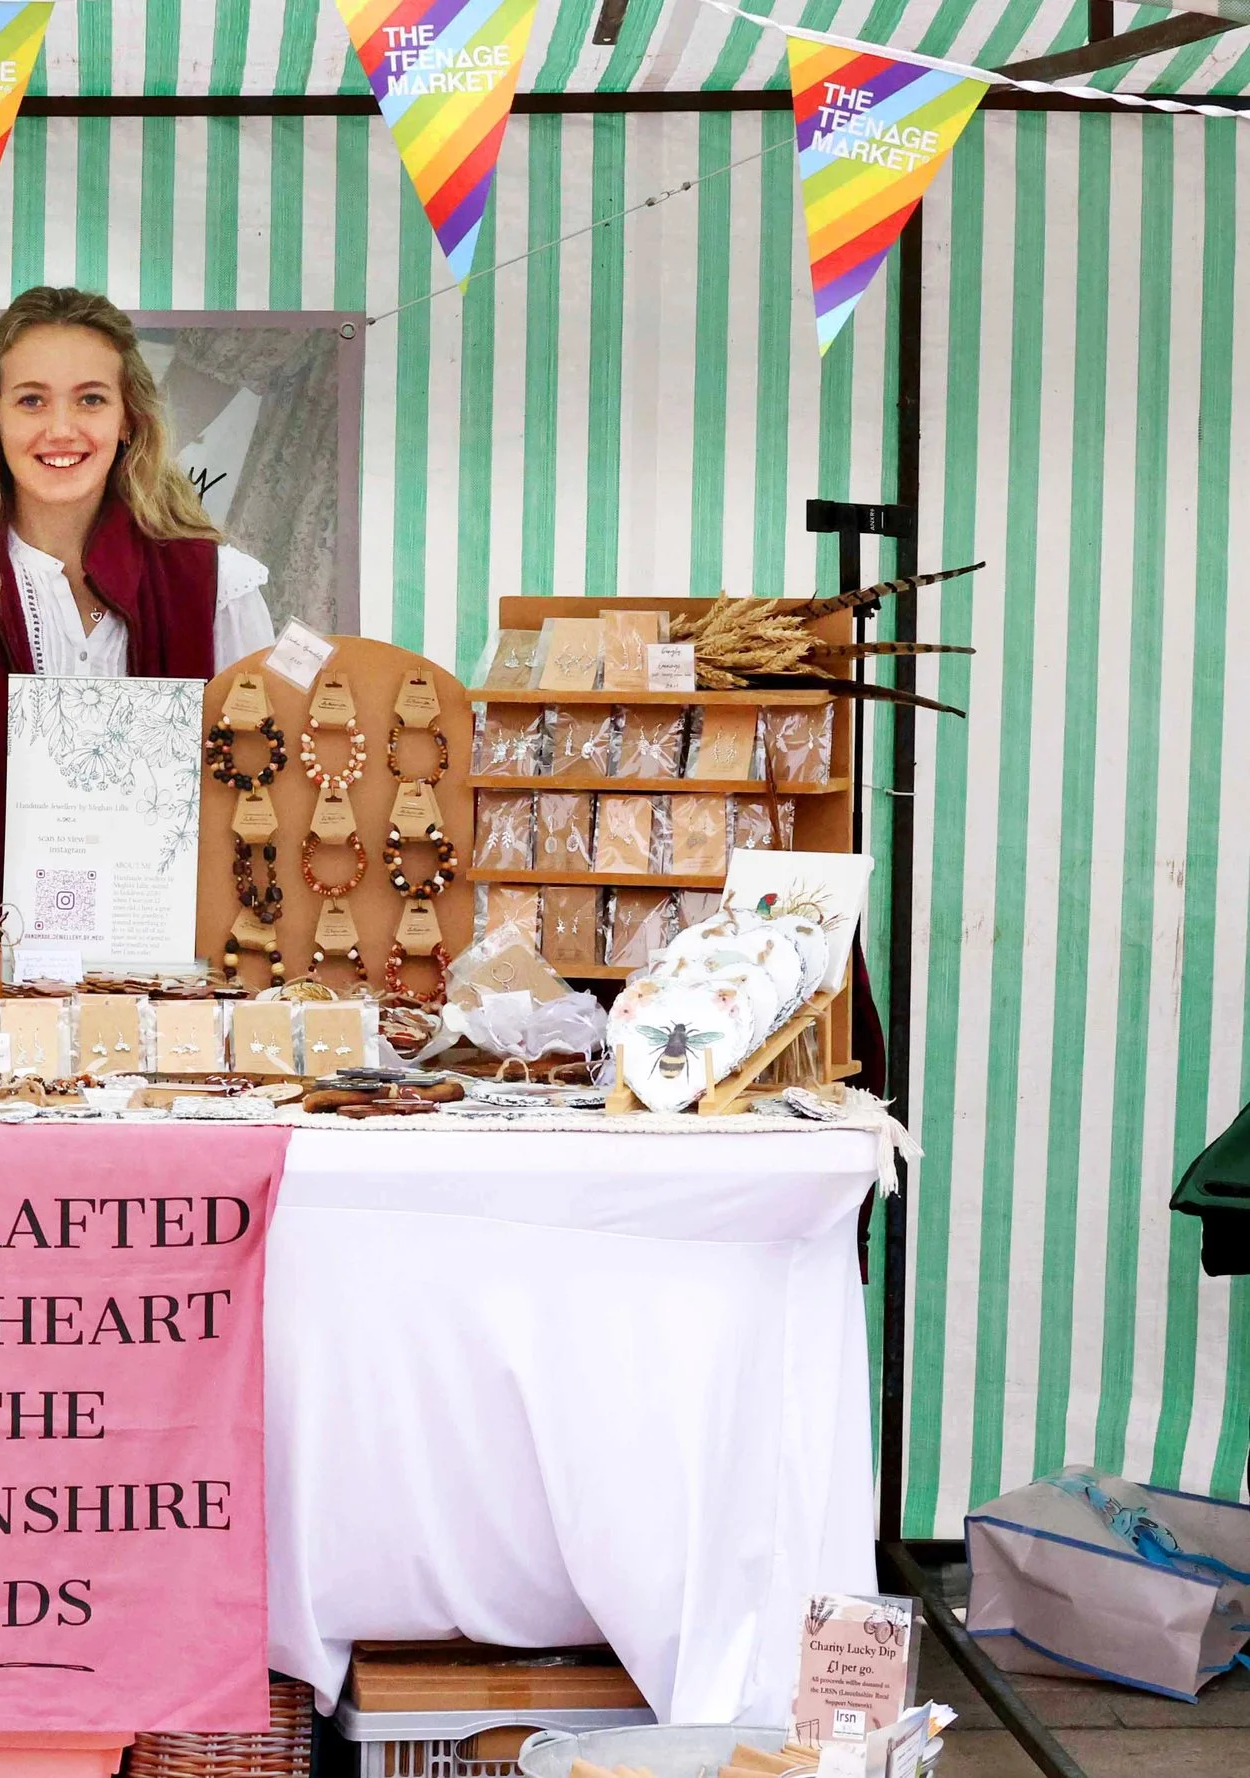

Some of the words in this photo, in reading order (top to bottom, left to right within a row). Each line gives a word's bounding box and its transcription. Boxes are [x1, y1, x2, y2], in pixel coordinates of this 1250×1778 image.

[382, 24, 434, 48] THE
[384, 45, 510, 72] TEENAGE
[823, 81, 874, 112] THE
[818, 106, 939, 153] TEENAGE
[79, 803, 86, 812] by
[810, 1640, 844, 1655] Charity
[847, 1643, 876, 1658] Lucky
[879, 1646, 896, 1660] Dip
[827, 1660, 838, 1673] £1
[842, 1663, 857, 1675] per
[859, 1666, 874, 1676] go.
